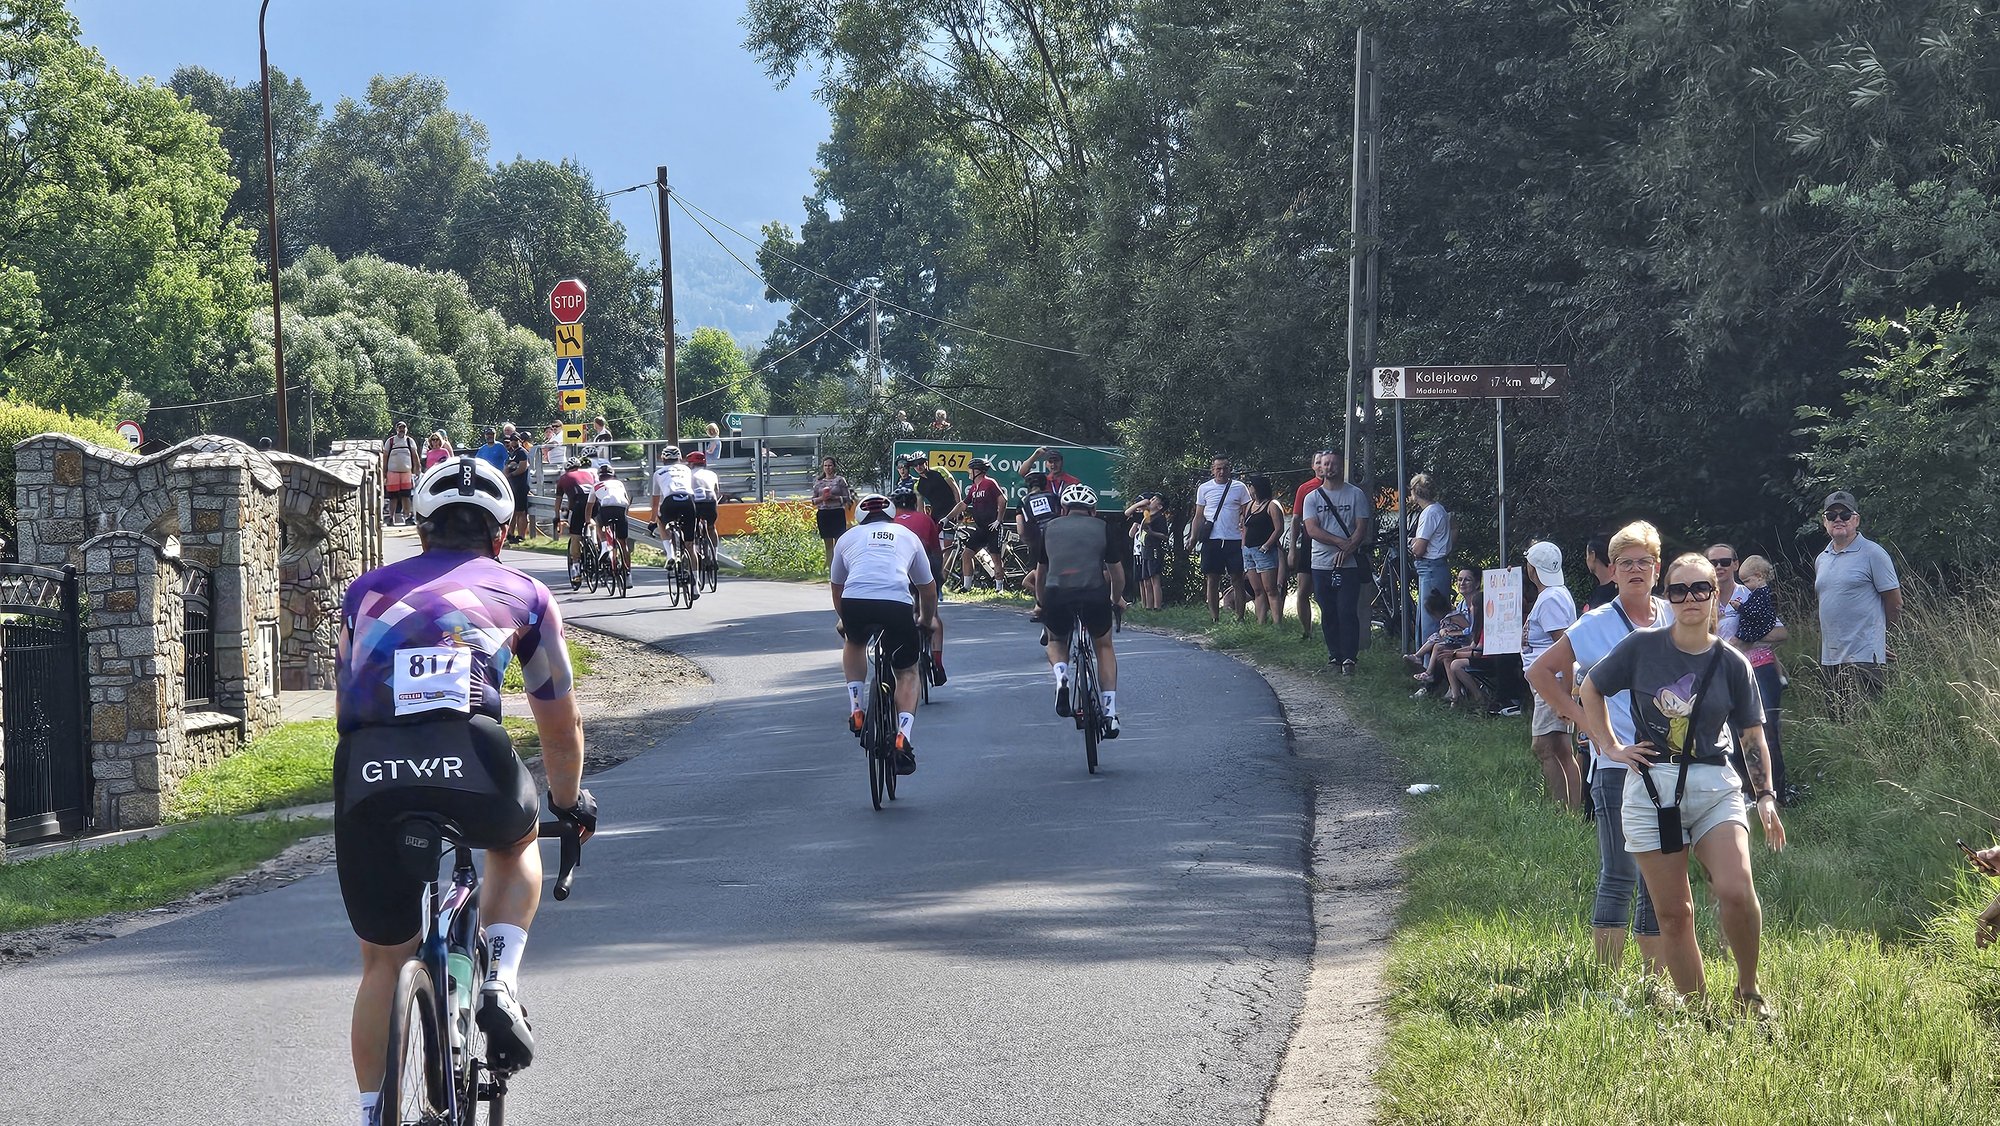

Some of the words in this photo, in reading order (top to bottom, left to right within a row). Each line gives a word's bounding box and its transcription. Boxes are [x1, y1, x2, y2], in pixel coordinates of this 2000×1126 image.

[554, 294, 582, 309] STOP
[1415, 371, 1478, 385] Kolejkowo
[1505, 377, 1522, 387] km
[937, 454, 966, 469] 367
[871, 531, 895, 541] 1550
[409, 651, 460, 678] 817
[361, 756, 464, 783] GTWR
